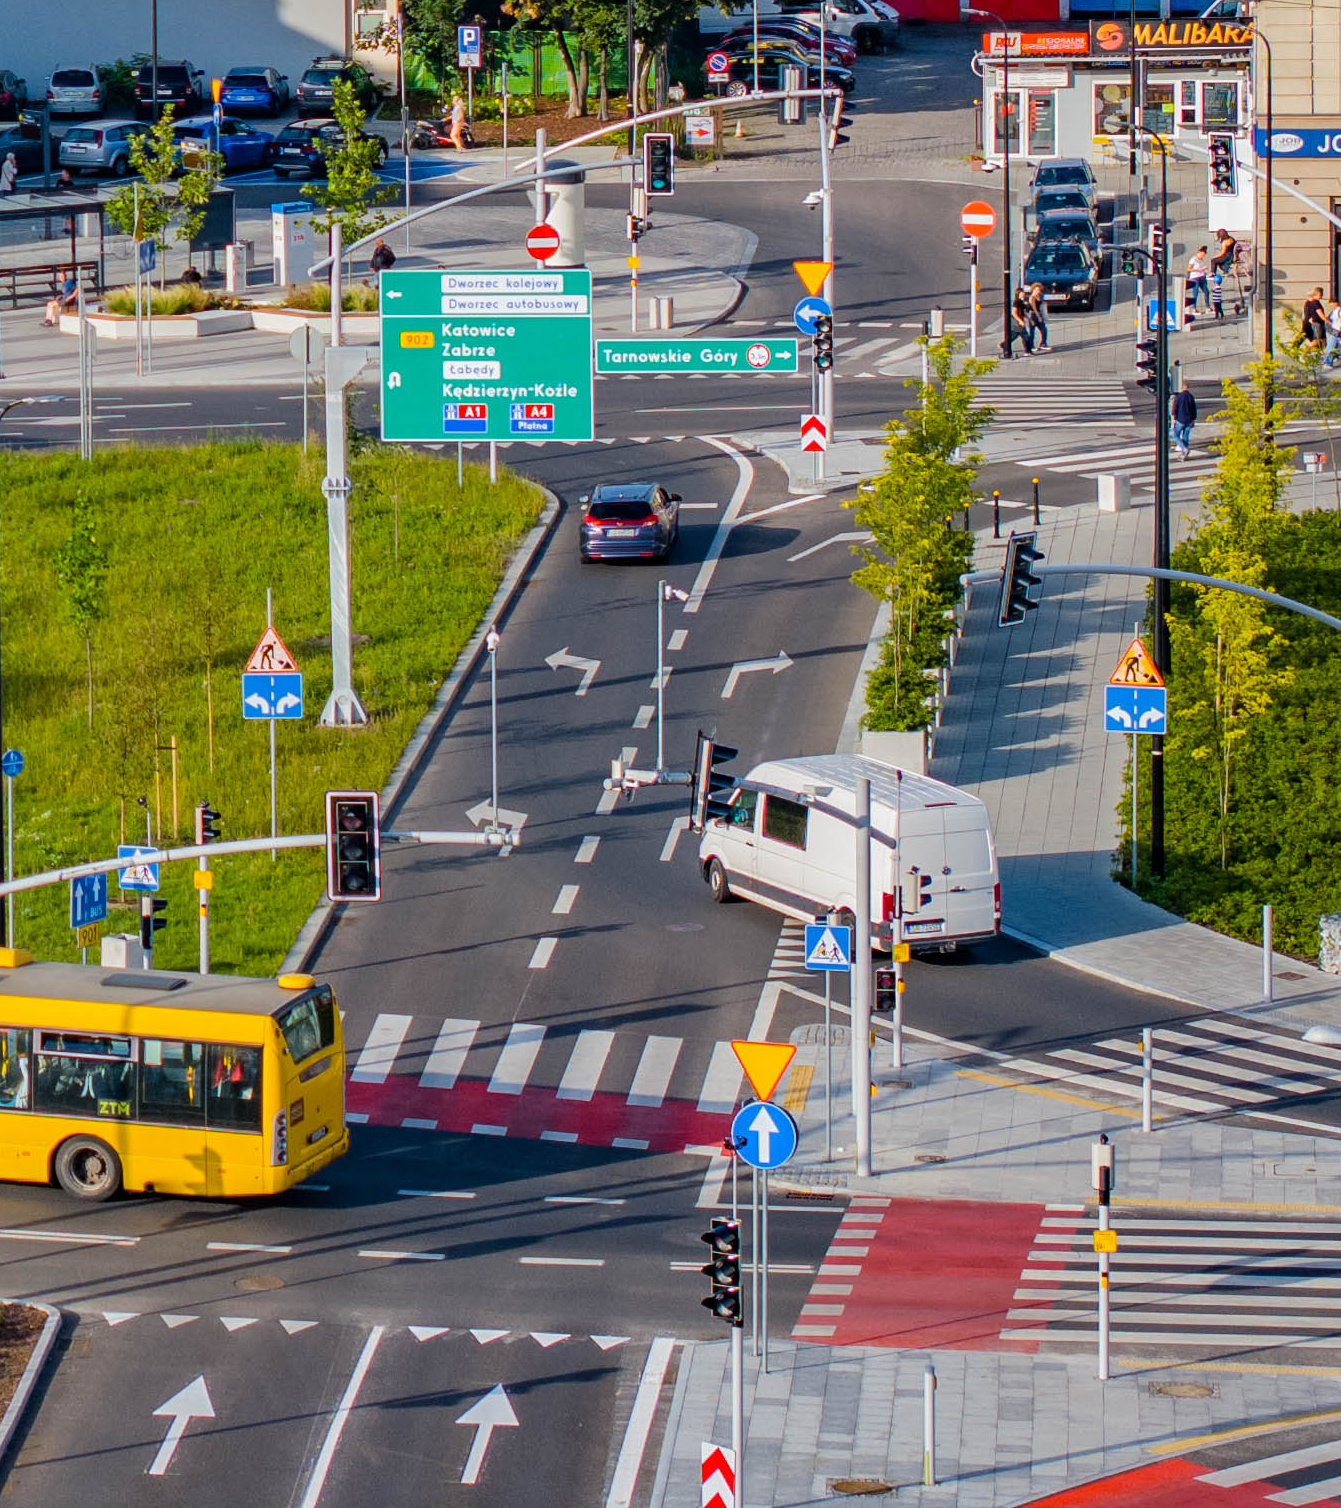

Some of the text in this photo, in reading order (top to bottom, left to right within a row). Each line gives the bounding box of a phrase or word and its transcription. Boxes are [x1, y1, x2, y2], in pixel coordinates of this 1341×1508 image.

[463, 29, 475, 46] P
[448, 278, 559, 292] Dworzec kolejowy
[449, 299, 579, 312] Dworzec autobusowy
[442, 323, 516, 337] Katowice
[406, 335, 430, 345] 902
[442, 343, 496, 357] Zabrze
[603, 349, 692, 363] Tarnowskie
[700, 348, 738, 367] Góry
[449, 364, 495, 377] Łabędy
[442, 383, 578, 401] Kędzierzyn-Koźle
[464, 406, 548, 418] A1 A4
[518, 421, 548, 431] Płatna
[90, 907, 102, 919] BUS
[82, 926, 97, 944] 901
[99, 1101, 131, 1117] ZTM
